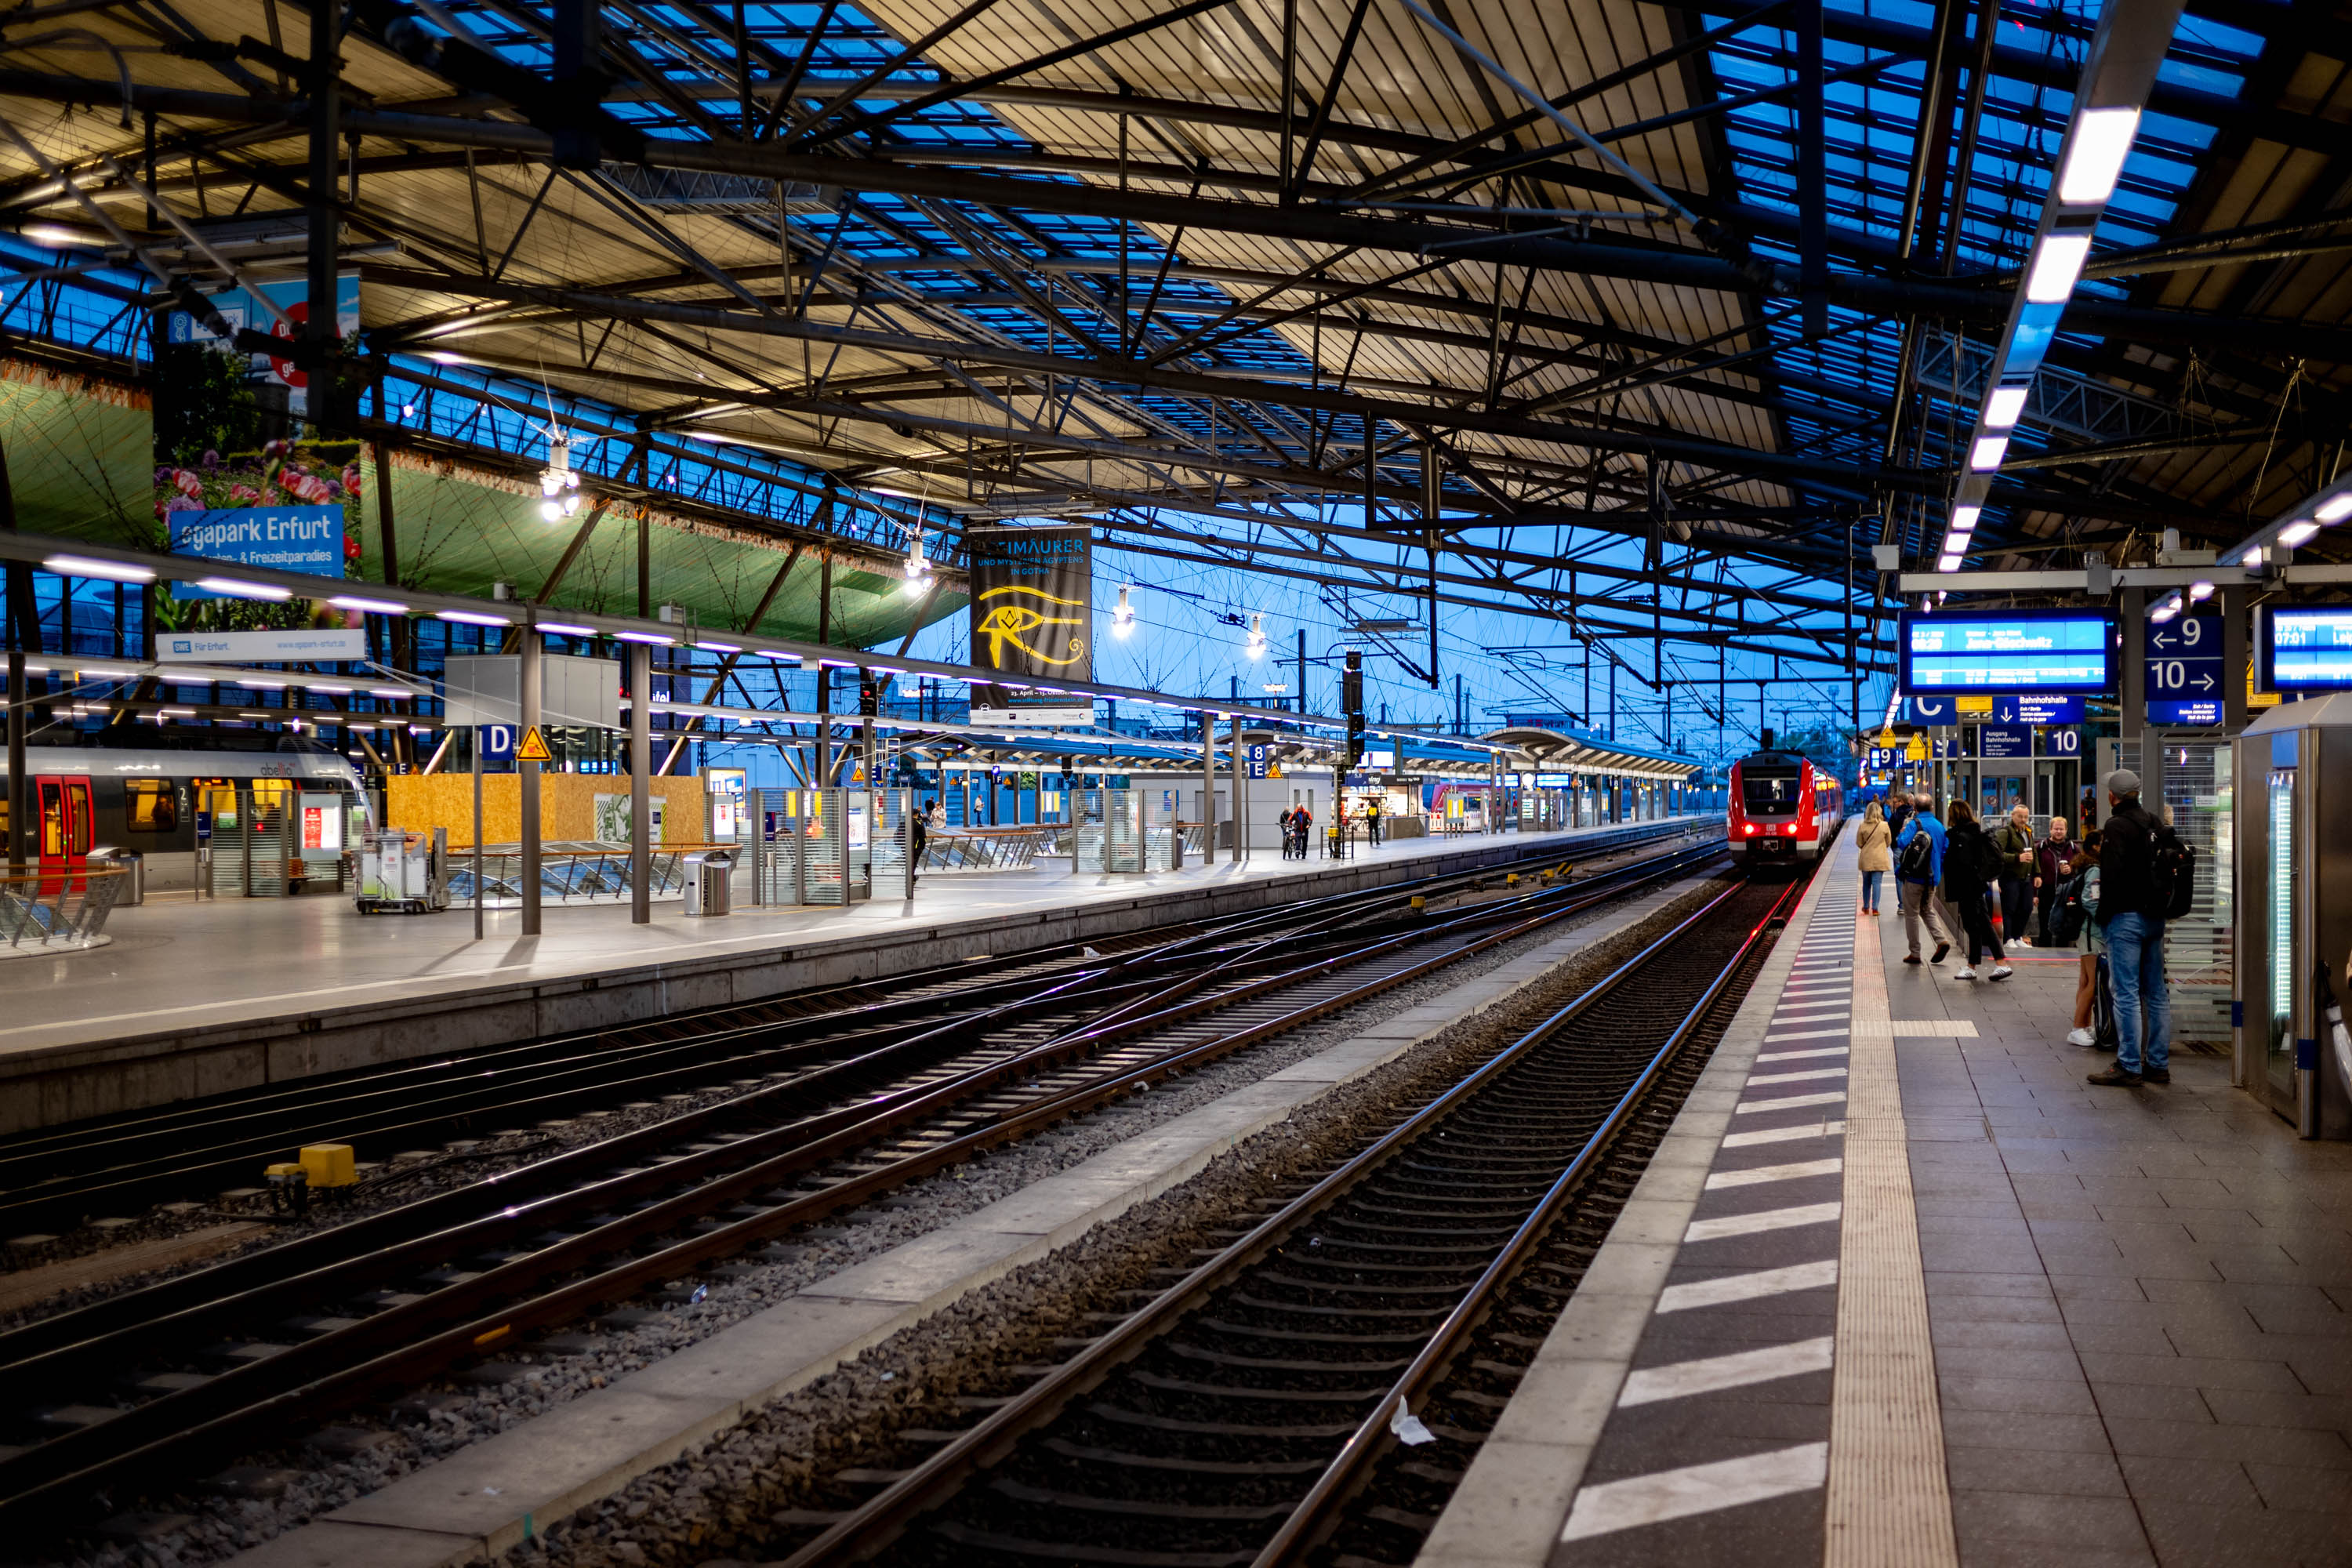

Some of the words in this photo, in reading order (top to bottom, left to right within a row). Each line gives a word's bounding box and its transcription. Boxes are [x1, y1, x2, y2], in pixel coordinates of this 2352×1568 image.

[181, 517, 262, 552] egapark
[267, 514, 332, 541] Erfurt
[240, 552, 248, 564] &
[249, 550, 332, 565] Freizeitparadies
[978, 558, 996, 567] UND
[1042, 556, 1084, 564] ÄGYPTENS
[1022, 567, 1050, 575] GOTHA
[2181, 618, 2201, 646] 9
[2275, 632, 2307, 644] 07:01
[175, 643, 190, 652] SWE
[194, 642, 206, 651] Für
[2151, 661, 2185, 689] 10
[2019, 695, 2068, 704] Bahnhofshalle
[491, 725, 510, 753] D
[2053, 731, 2078, 751] 10
[1254, 746, 1264, 760] 8
[1881, 749, 1891, 764] 9
[260, 761, 293, 776] abellio
[399, 764, 407, 775] E
[1255, 763, 1264, 776] E
[180, 787, 187, 800] 2
